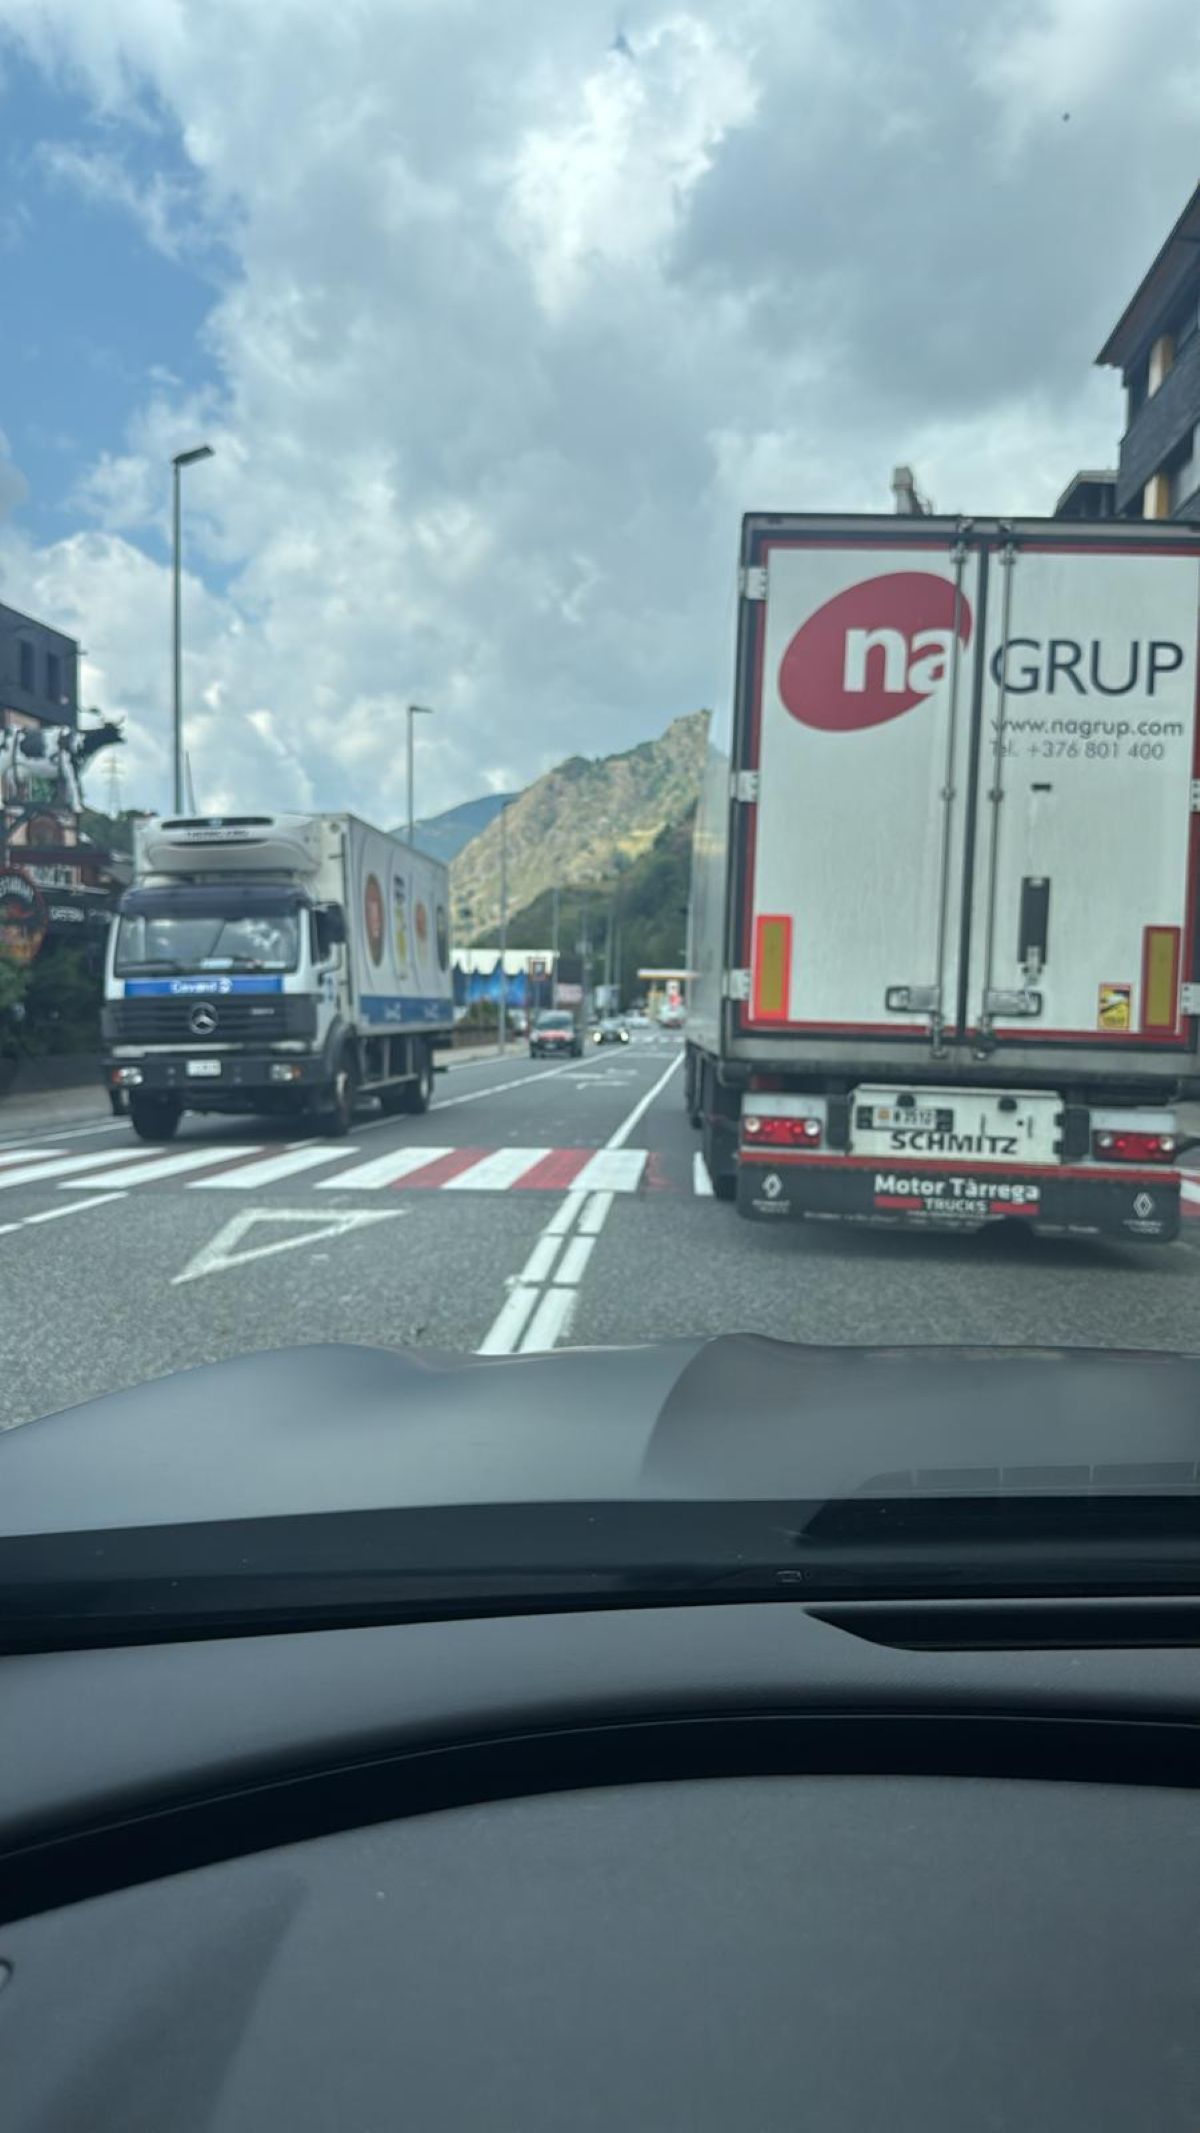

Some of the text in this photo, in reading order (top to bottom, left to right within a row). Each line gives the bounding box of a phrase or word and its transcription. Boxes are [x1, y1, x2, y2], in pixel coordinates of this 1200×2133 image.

[843, 628, 1184, 696] na GRUP
[991, 718, 1184, 738] www.nagrup.com
[1027, 742, 1078, 759] +376
[1085, 743, 1119, 760] 801
[1127, 743, 1165, 760] 400
[891, 1131, 1018, 1155] SCHMITZ
[874, 1173, 1041, 1205] Motor Tàrrega
[924, 1198, 988, 1213] TRUCKS
